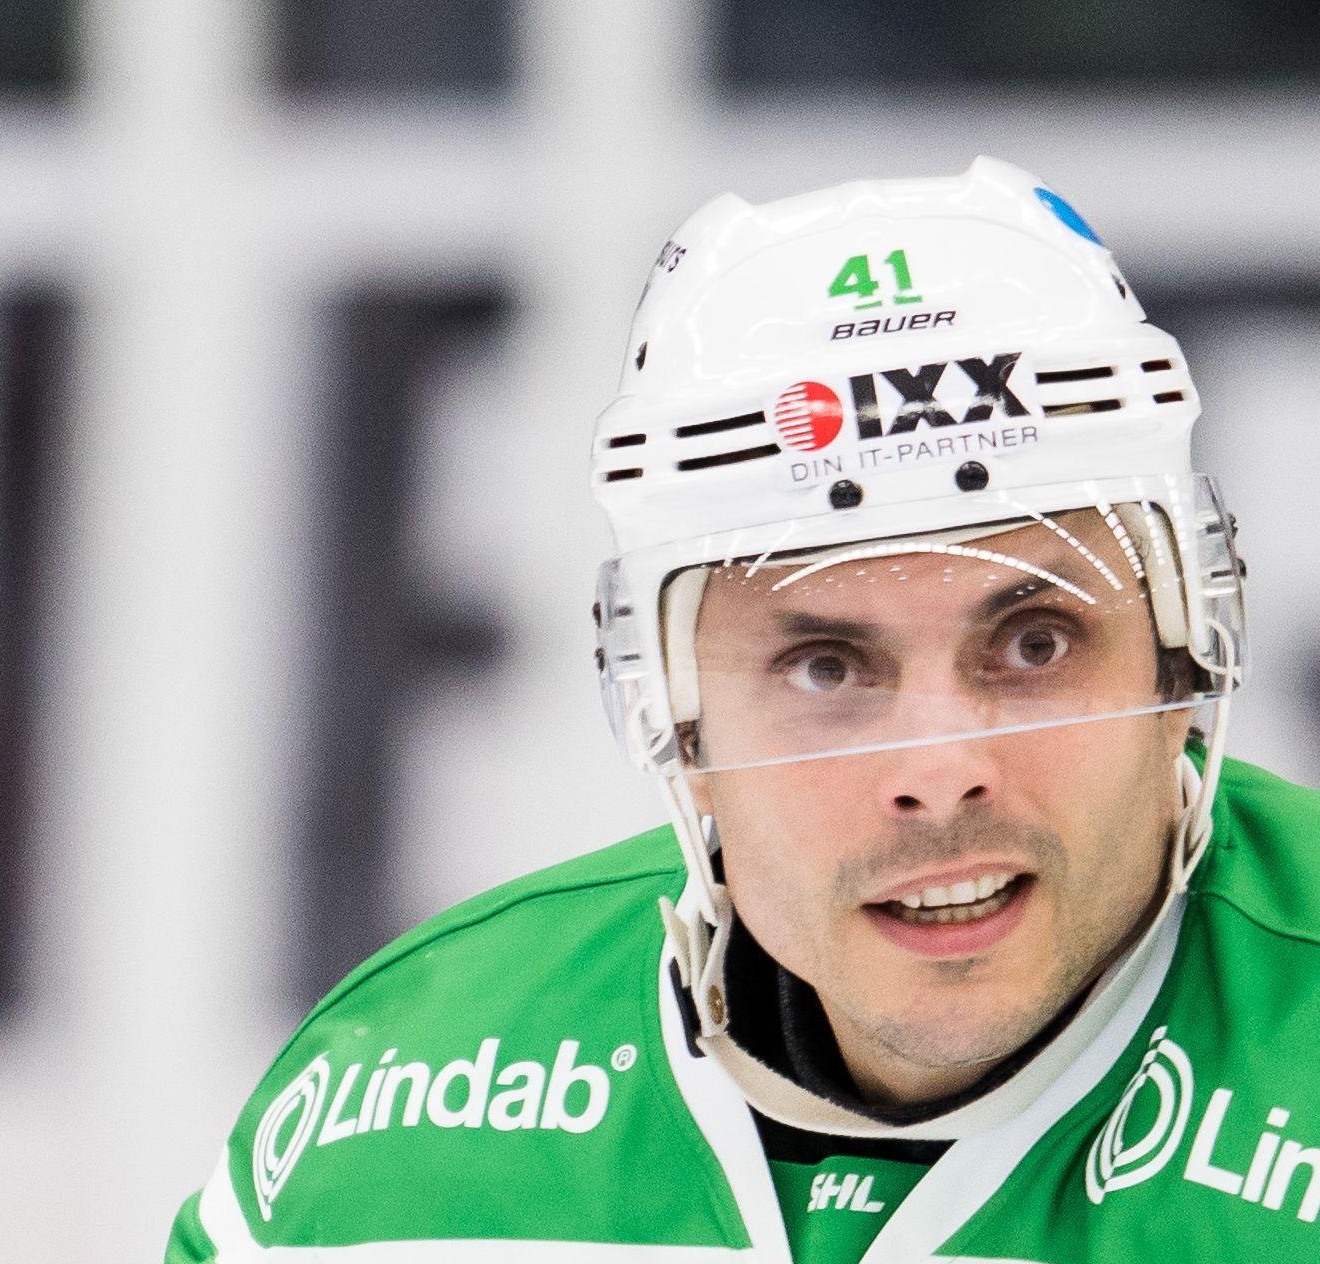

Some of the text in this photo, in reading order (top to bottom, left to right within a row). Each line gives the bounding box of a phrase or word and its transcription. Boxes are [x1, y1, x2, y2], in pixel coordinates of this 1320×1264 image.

[828, 249, 923, 310] 41
[830, 310, 957, 341] BAUER
[848, 351, 1032, 441] IXX
[790, 424, 1039, 483] DIN IT-PARTNER
